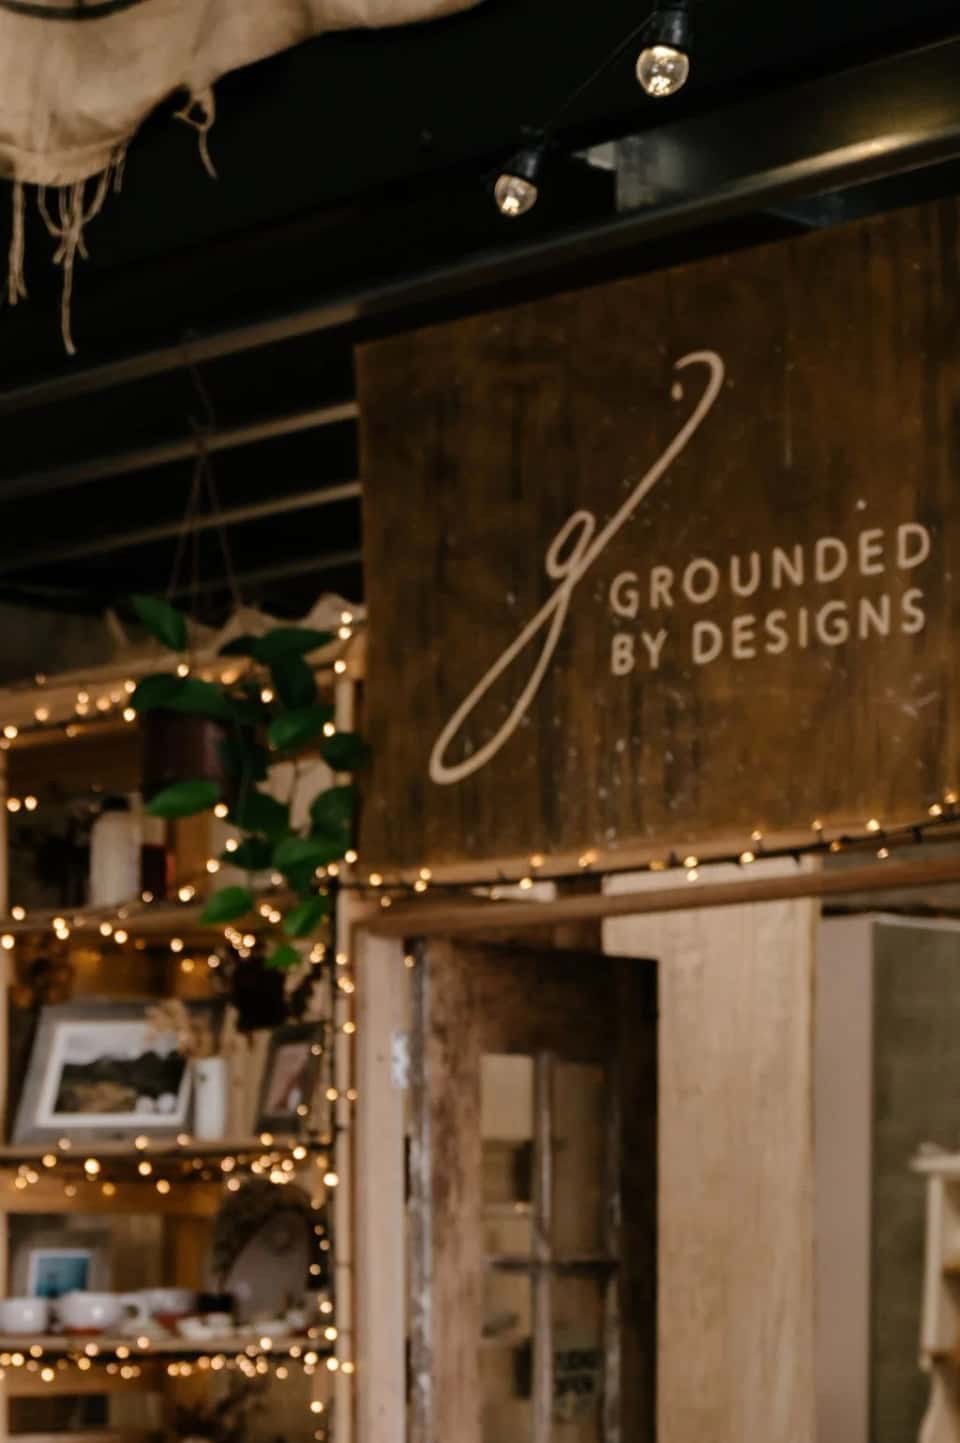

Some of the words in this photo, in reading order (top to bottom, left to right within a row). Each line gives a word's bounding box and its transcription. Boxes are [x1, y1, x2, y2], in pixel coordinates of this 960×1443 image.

[609, 522, 931, 619] GROUNDED
[610, 628, 668, 677] BY
[692, 587, 926, 665] DESIGNS
